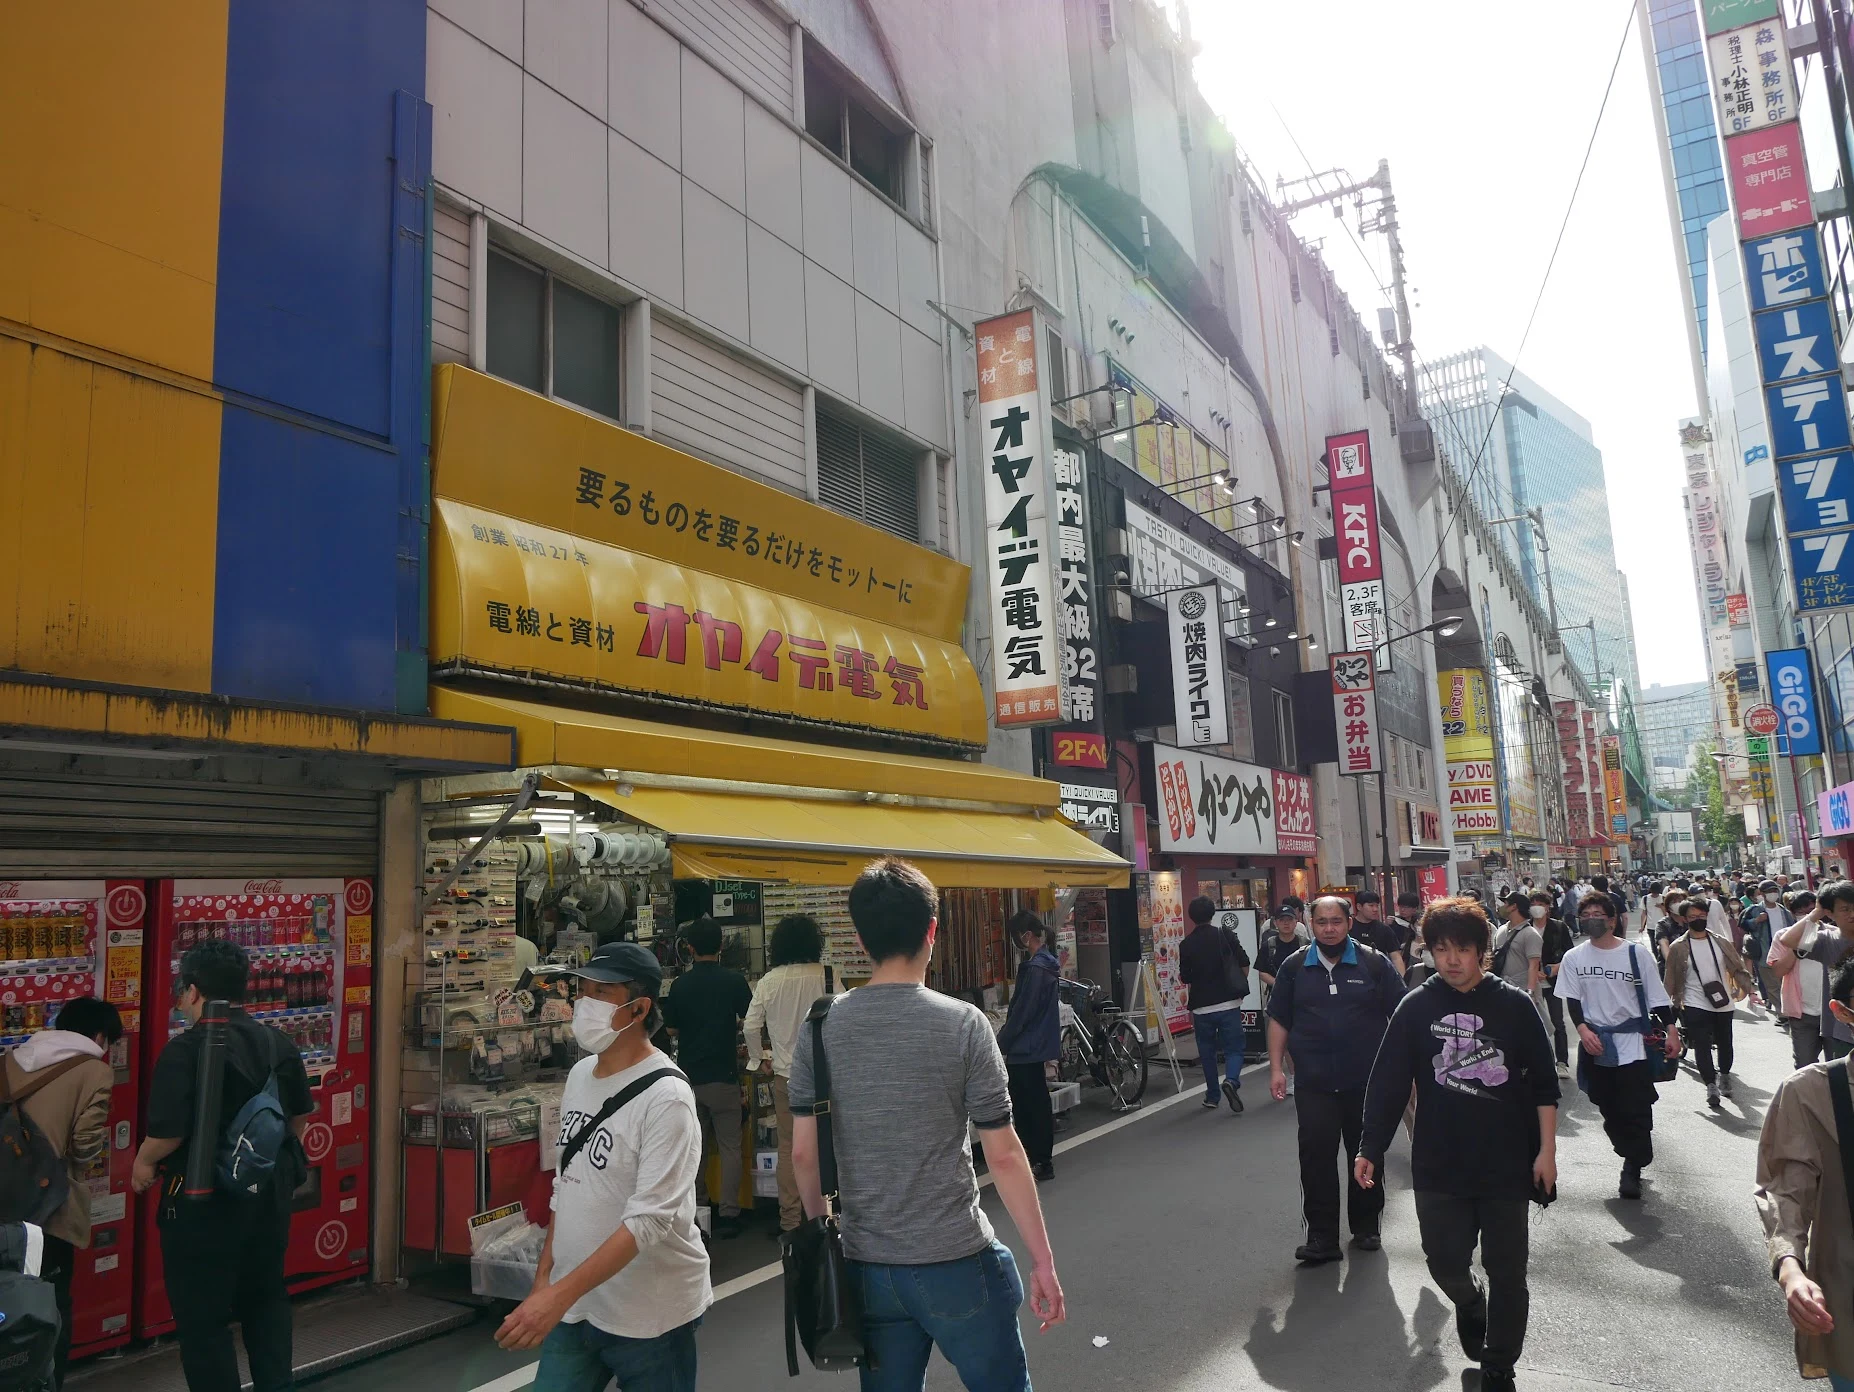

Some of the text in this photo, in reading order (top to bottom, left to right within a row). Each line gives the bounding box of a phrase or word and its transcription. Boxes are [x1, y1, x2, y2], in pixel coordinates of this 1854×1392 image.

[1755, 28, 1784, 107] 森事務所
[1732, 116, 1751, 131] 6F
[1768, 107, 1787, 122] 6F
[1741, 145, 1788, 167] 真空管
[1744, 165, 1792, 187] 専門店
[471, 523, 590, 567] 創業 昭和 27 年
[575, 466, 914, 604] 要るものを要るだけをモットーに
[990, 406, 1046, 680] オヤイデ電気
[1145, 516, 1177, 547] TASTY!
[1208, 553, 1232, 579] VALUE!
[1342, 502, 1372, 570] KFC
[487, 600, 616, 653] 電線と資材
[1350, 601, 1379, 617] 客席
[633, 601, 930, 711] オヤイデ電気
[1182, 621, 1210, 720] 焼肉ライク
[1334, 657, 1369, 688] かつや
[999, 698, 1056, 717] 通信販売
[1777, 665, 1811, 739] GiGO
[1343, 694, 1372, 771] お弁当
[1753, 714, 1777, 727] 消火栓
[1161, 765, 1180, 831] とんかつ
[1197, 760, 1271, 845] かつや
[1276, 773, 1310, 809] カツ丼
[1056, 800, 1111, 832] 肉ライク
[1280, 804, 1311, 833] とんかつ
[1452, 1028, 1475, 1038] STORY
[1481, 1046, 1495, 1057] End
[1446, 1078, 1478, 1095] Your World
